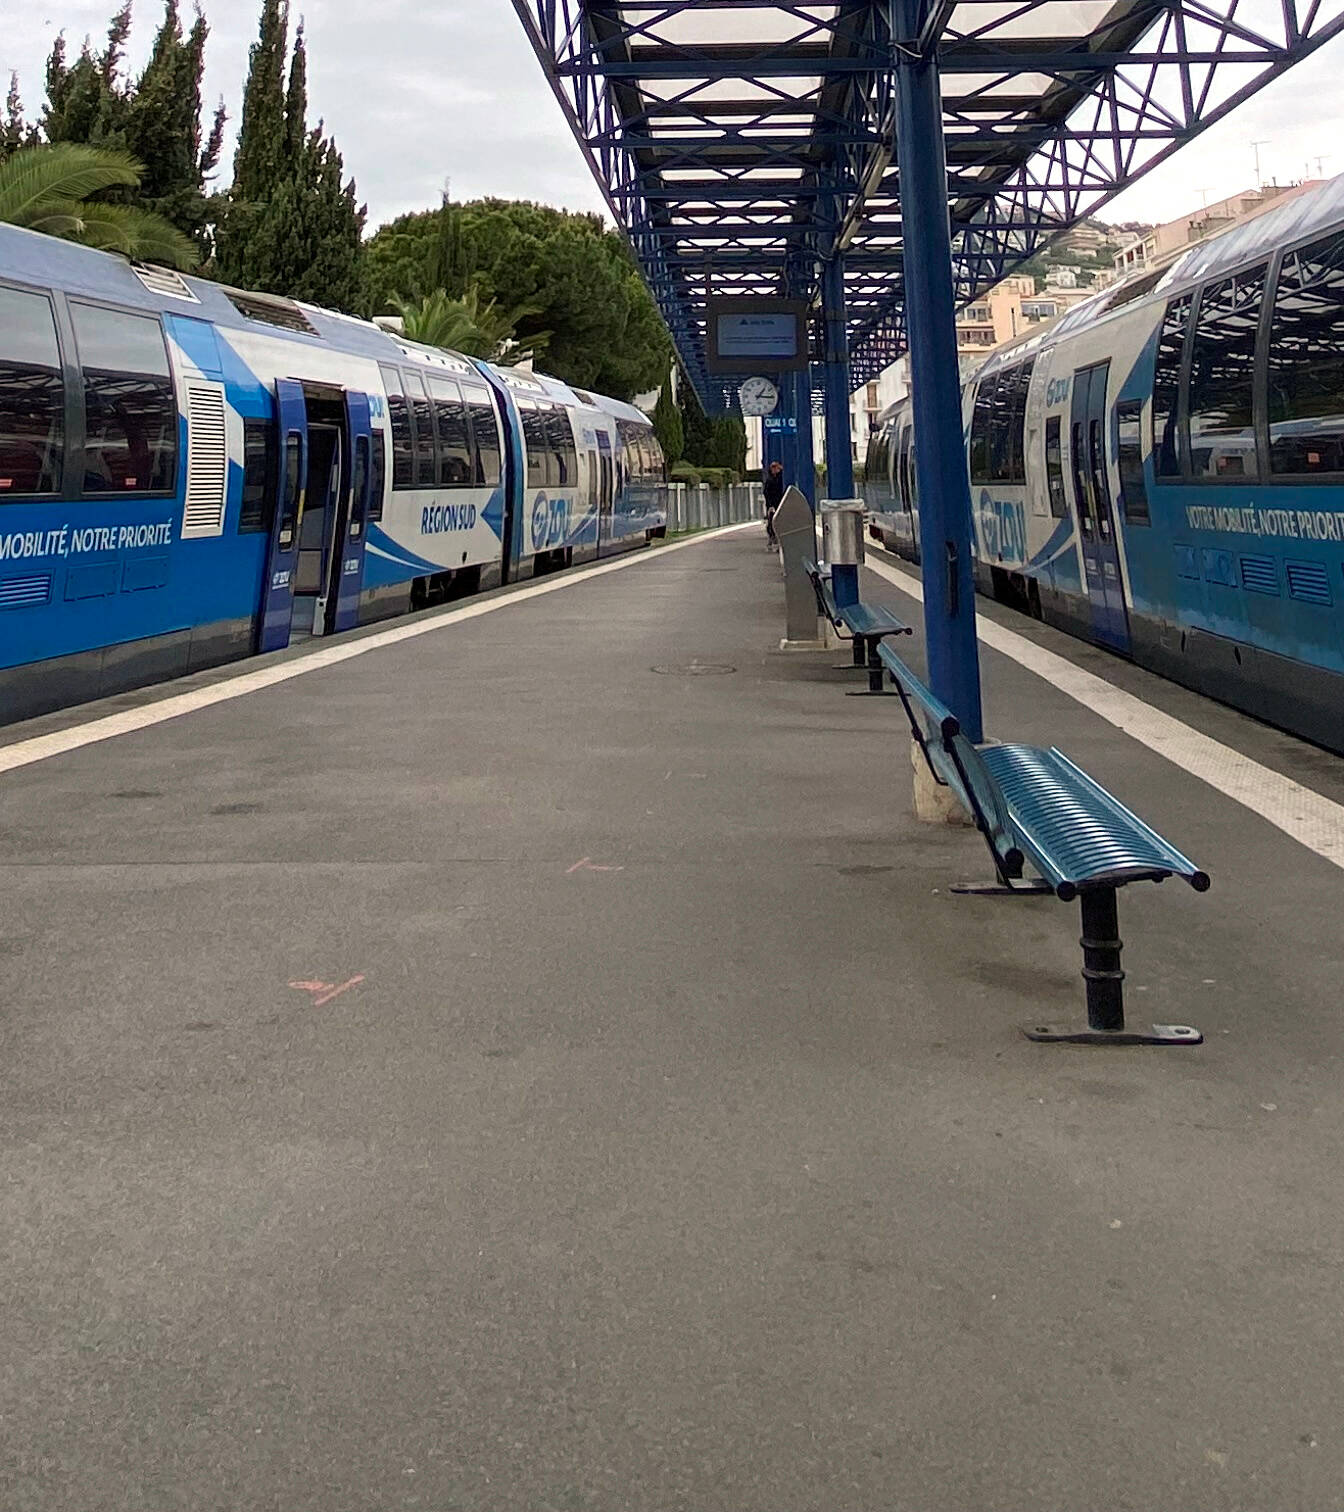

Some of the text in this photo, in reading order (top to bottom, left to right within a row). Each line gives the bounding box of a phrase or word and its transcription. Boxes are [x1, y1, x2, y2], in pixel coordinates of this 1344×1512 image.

[421, 499, 476, 535] RÉGION SUD
[1186, 505, 1214, 529] VOTRE
[1258, 509, 1297, 538] NOTRE
[70, 527, 117, 553] NOTRE
